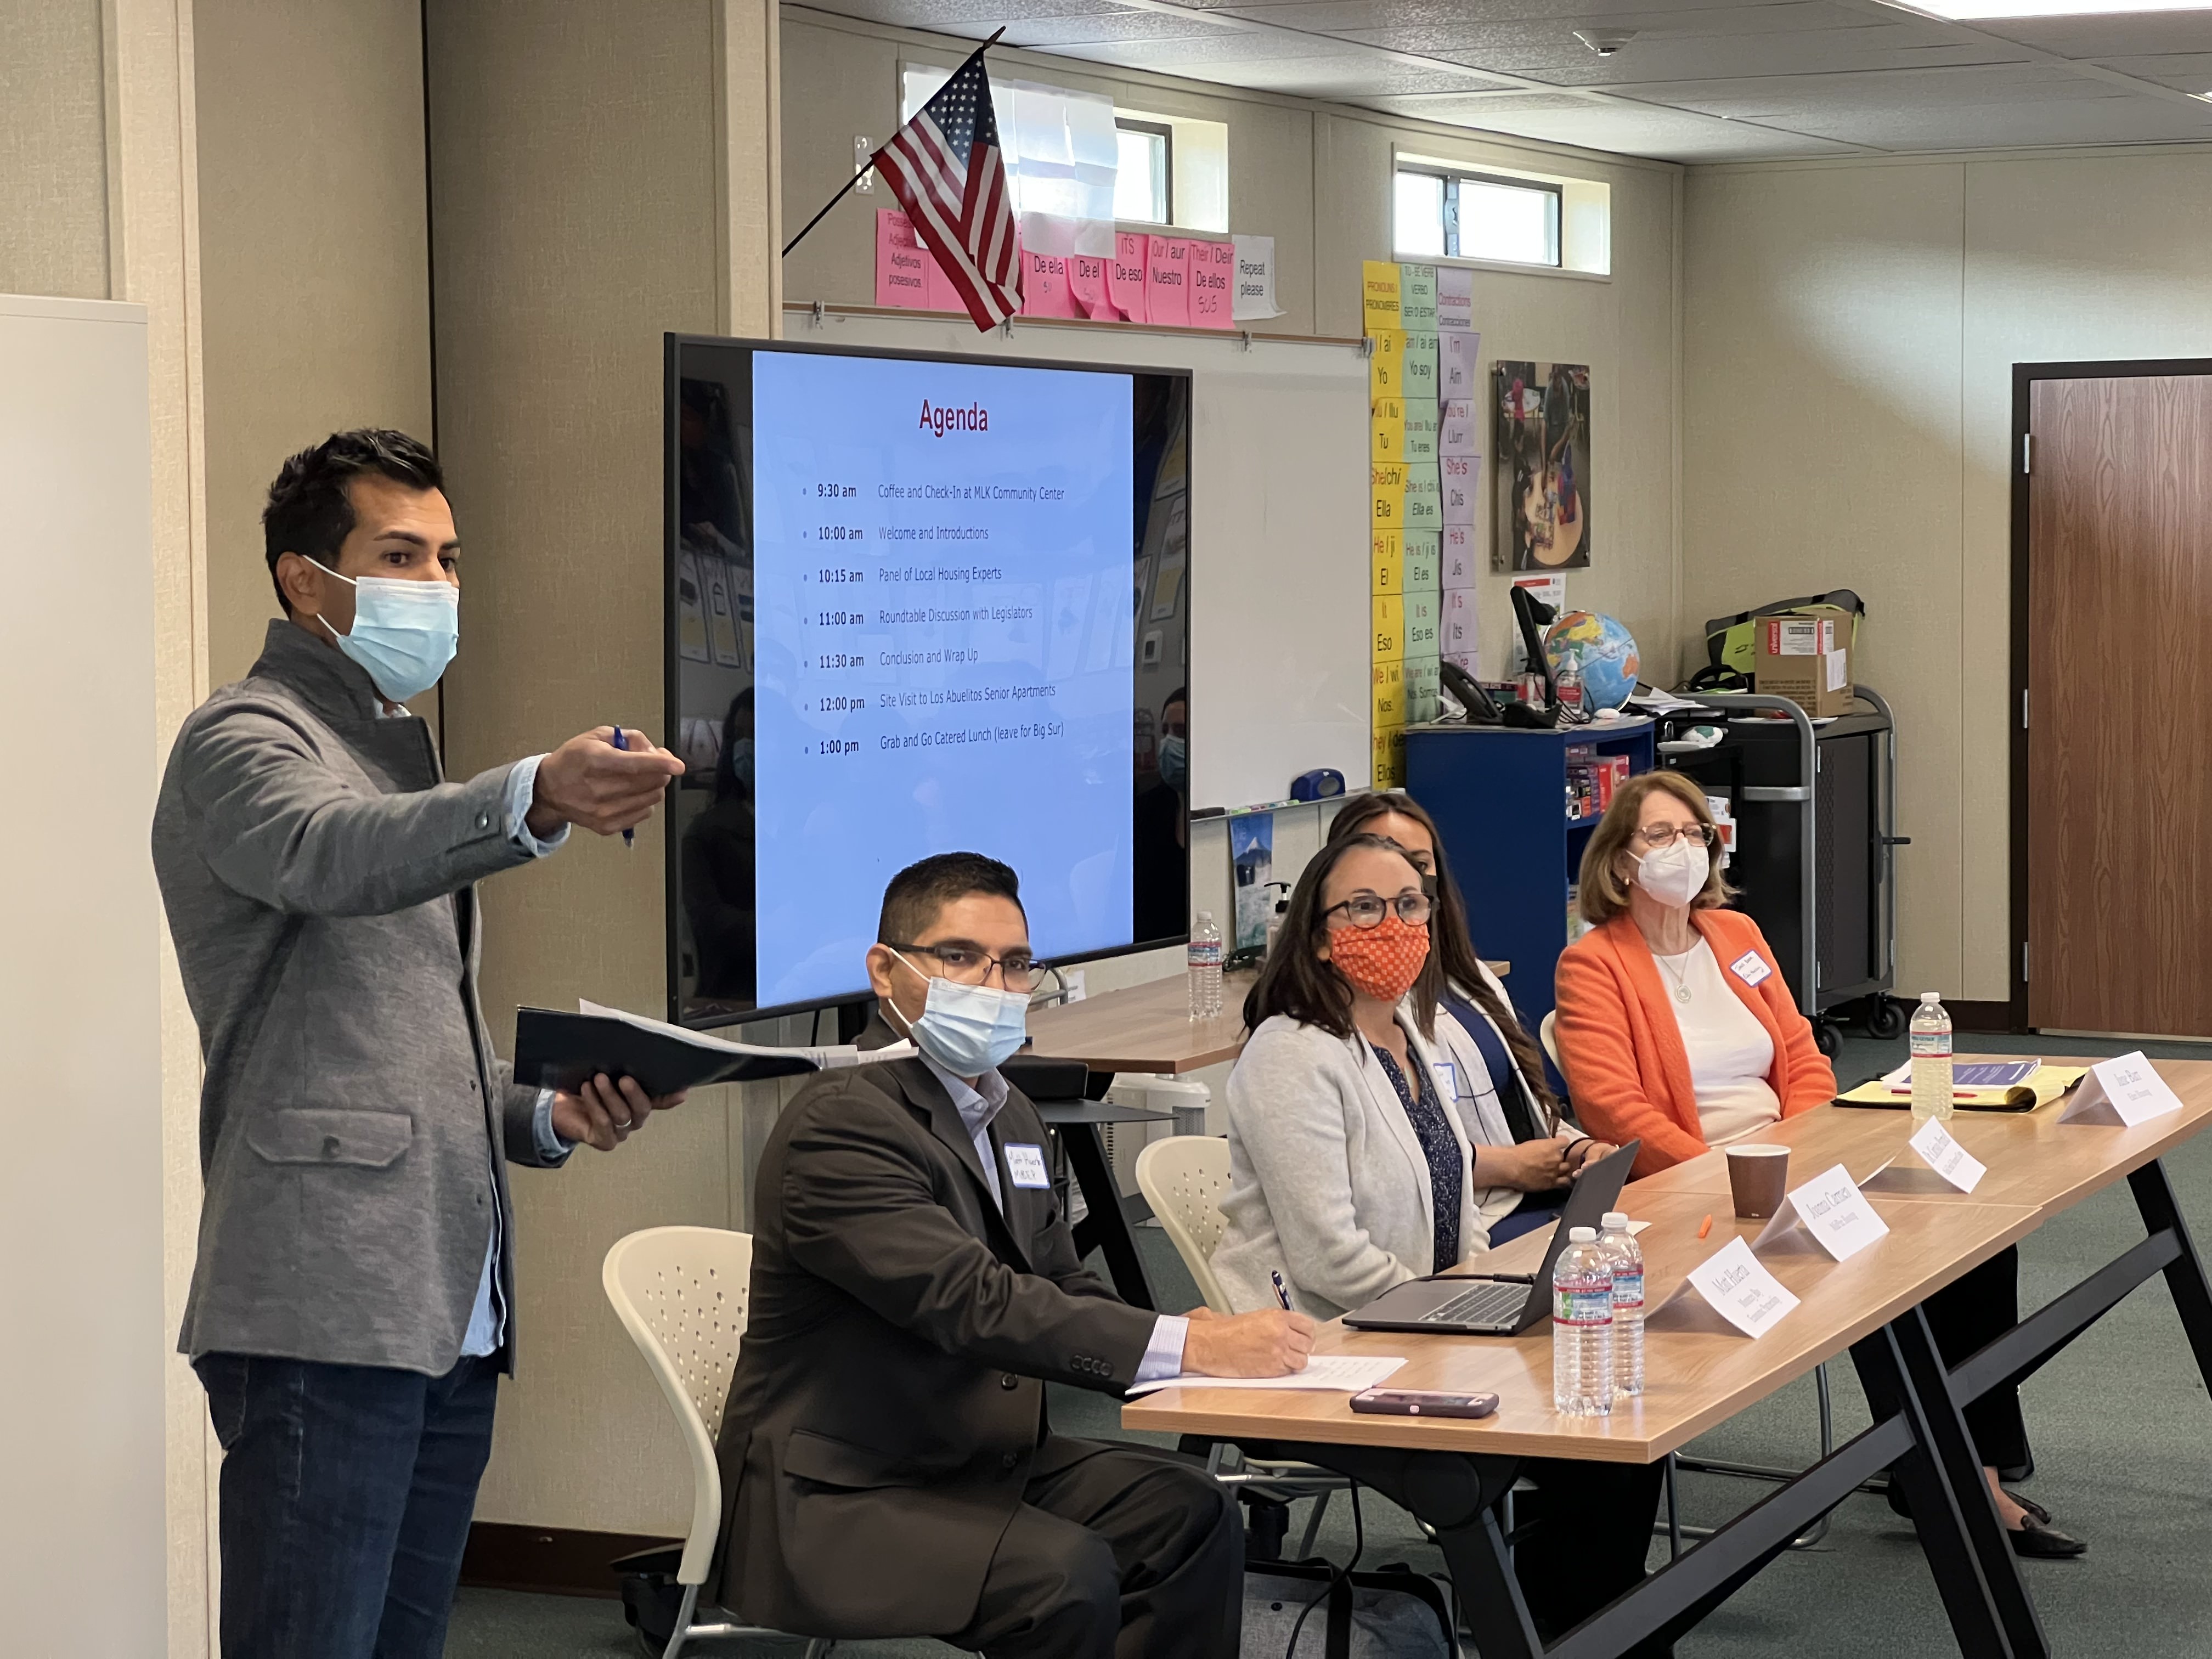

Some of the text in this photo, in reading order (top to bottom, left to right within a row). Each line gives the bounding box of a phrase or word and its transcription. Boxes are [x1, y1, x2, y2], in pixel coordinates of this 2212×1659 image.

[1153, 240, 1164, 258] Our
[1171, 246, 1185, 259] aur
[1191, 244, 1209, 261] Their
[1215, 247, 1234, 264] Deir
[891, 252, 921, 269] Adjetivos
[1035, 256, 1064, 275] De ella
[1079, 261, 1099, 278] De el
[1240, 259, 1265, 278] Repeat
[1116, 263, 1143, 281] De eso
[1153, 267, 1182, 285] Nuestro
[1197, 270, 1225, 289] De ellos
[1240, 281, 1263, 298] please
[1412, 284, 1429, 295] VERBO
[1438, 292, 1471, 308] Contractions
[1384, 335, 1391, 352] ai
[1378, 366, 1388, 384] Yo
[1409, 360, 1431, 380] Yo soy
[919, 399, 989, 438] Agenda
[1379, 433, 1389, 449] Tu
[1410, 440, 1430, 453] Tu eres
[1447, 458, 1468, 475] She's
[817, 483, 1065, 503] 9:30 am Coffee and Check-In at MLK Community Center
[1451, 489, 1464, 506] Chis
[1376, 499, 1391, 517] Ella
[1412, 502, 1434, 516] Ella es
[818, 526, 989, 540] 10:00 am Welcome and Introductions
[1449, 528, 1465, 545] He's
[1374, 536, 1384, 554] He
[1406, 543, 1415, 556] He
[819, 567, 1002, 583] 10:15 am Panel of Local Housing Experts
[1381, 568, 1389, 586] El
[1414, 567, 1429, 580] El es
[819, 606, 1033, 626] 11:00 am Roundtable Discussion with Legislators
[1412, 627, 1434, 642] Eso es
[1452, 622, 1463, 640] Its
[1378, 633, 1393, 652] Eso
[820, 648, 978, 669] 11:30 am Conclusion and Wrap Up
[1390, 664, 1400, 682] wi
[820, 684, 1056, 713] 12:00 pm Site Visit to Los Abuelitos Senior Apartments
[820, 721, 1064, 756] 1:00 pm Grab and Go Catered Lunch (leave for Big Sur)
[1378, 763, 1396, 782] Ellos
